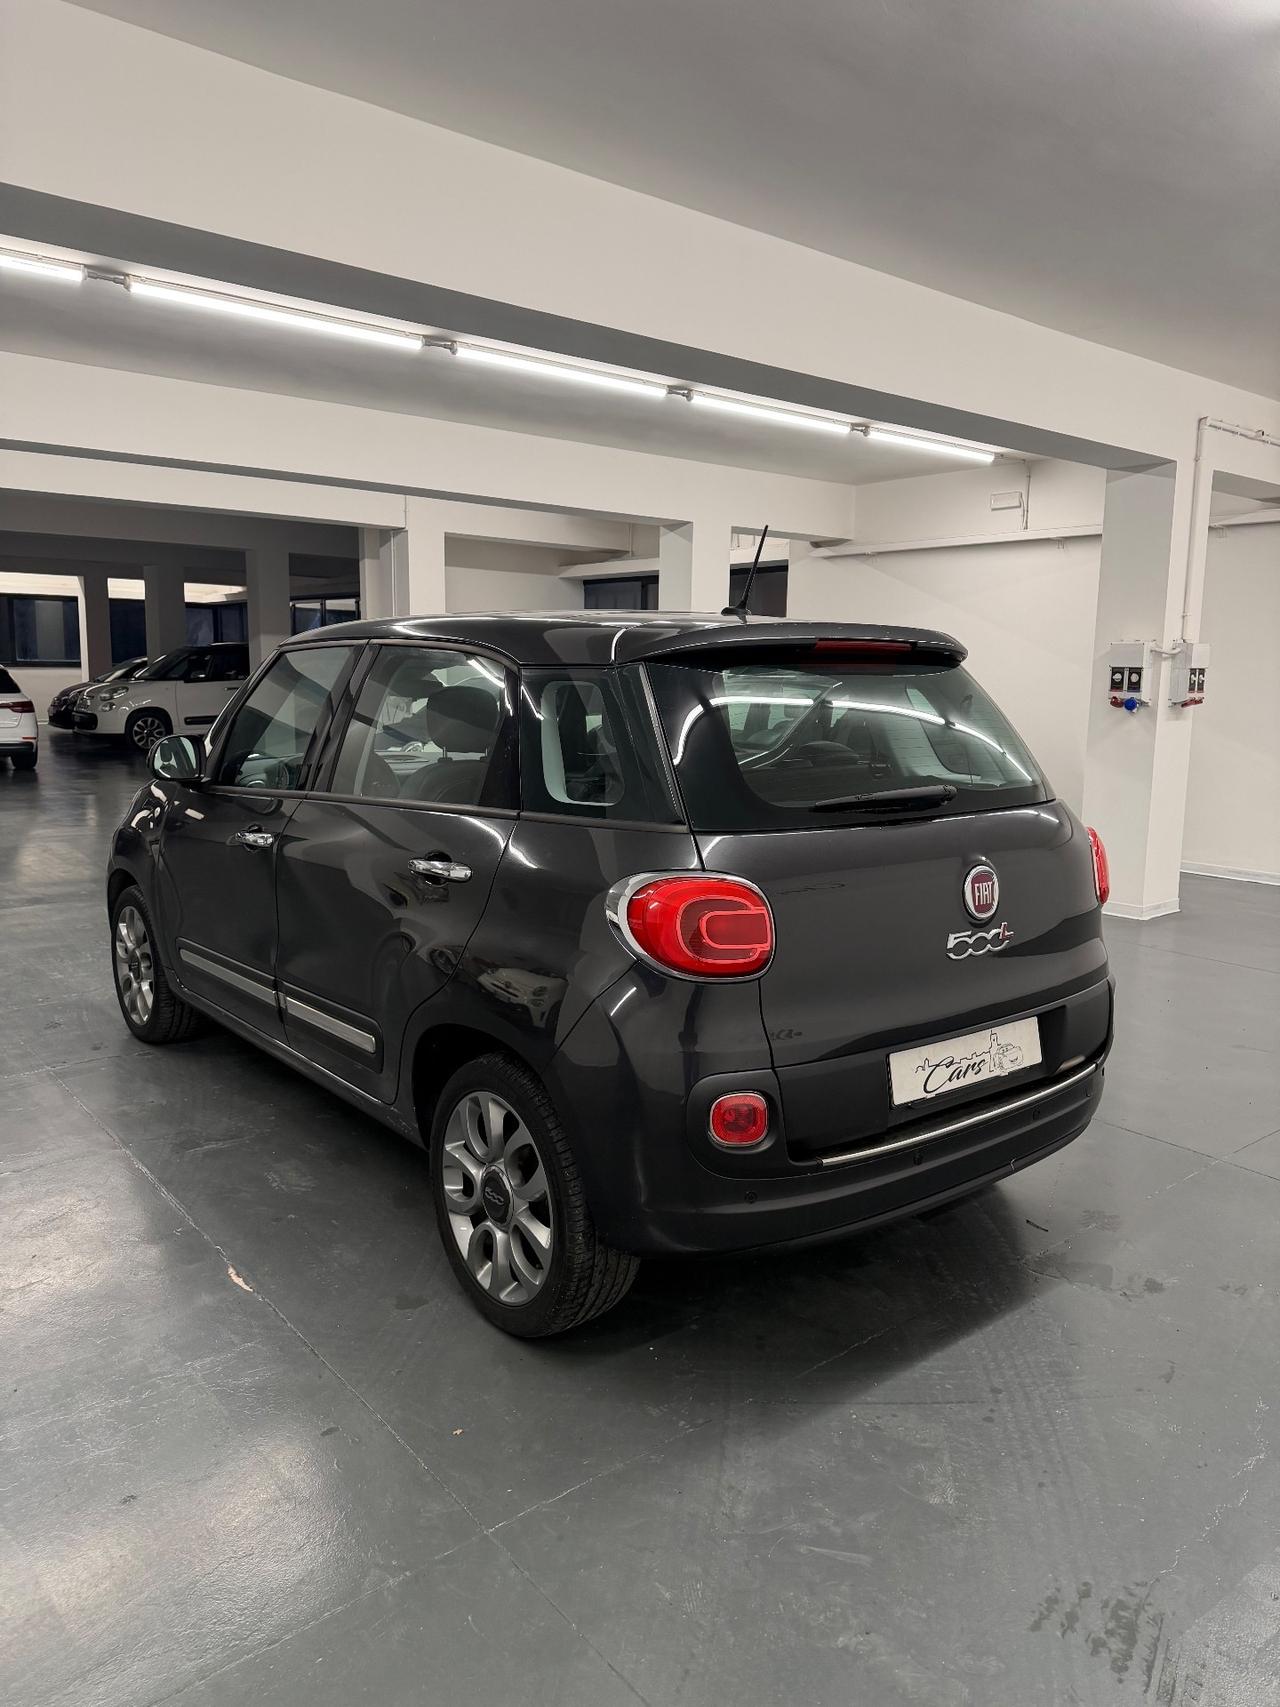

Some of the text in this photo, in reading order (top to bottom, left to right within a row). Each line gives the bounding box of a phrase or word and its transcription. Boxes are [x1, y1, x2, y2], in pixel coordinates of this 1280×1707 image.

[974, 881, 993, 906] FIAT
[946, 922, 1014, 960] 500L
[924, 1056, 987, 1094] Cars
